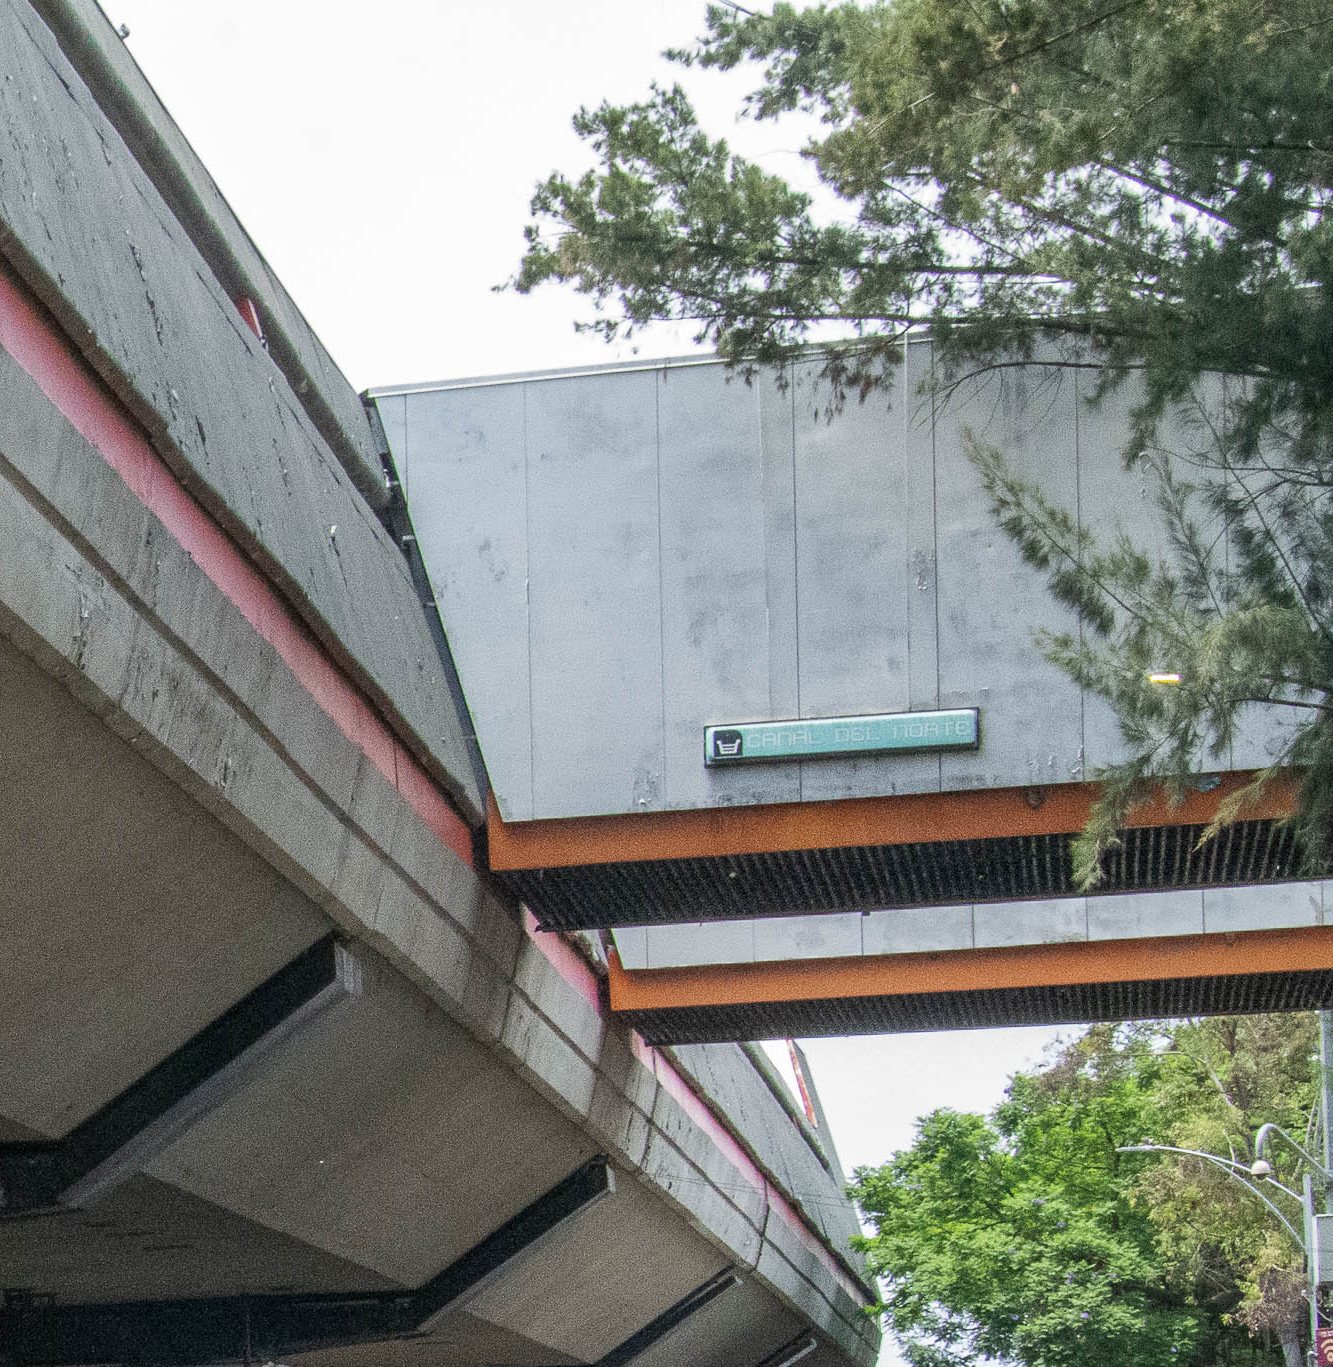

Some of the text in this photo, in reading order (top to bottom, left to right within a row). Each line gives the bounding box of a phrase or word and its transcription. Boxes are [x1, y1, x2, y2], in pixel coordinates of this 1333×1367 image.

[747, 719, 971, 748] CANAL DEL NORTE
